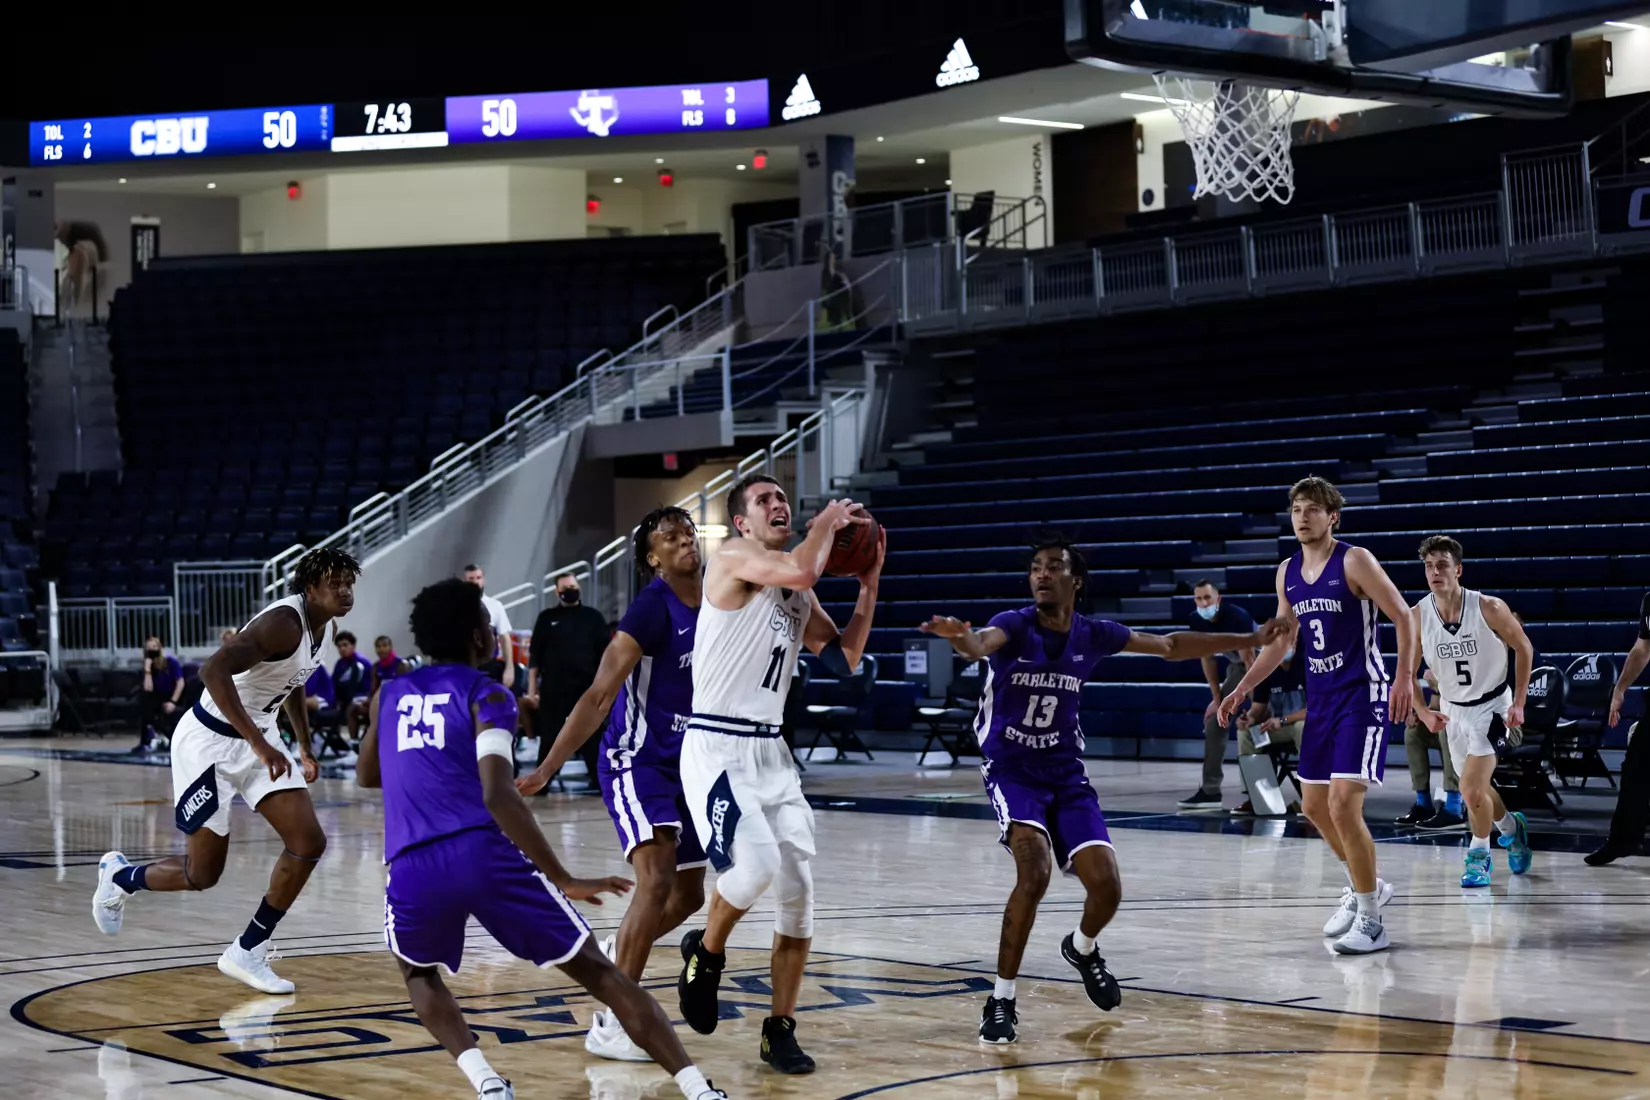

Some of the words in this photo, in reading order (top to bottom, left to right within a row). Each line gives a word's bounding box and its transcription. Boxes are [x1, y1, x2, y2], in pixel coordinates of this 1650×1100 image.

[725, 86, 736, 104] 3
[43, 124, 65, 141] TOL
[83, 121, 92, 139] 2
[262, 110, 297, 149] 50
[364, 102, 412, 134] 7:43
[481, 98, 517, 137] 50
[682, 109, 704, 126] FLS
[130, 115, 210, 157] CBU
[43, 144, 63, 160] FLS
[83, 142, 92, 159] 6
[1309, 618, 1326, 651] 3
[1307, 651, 1344, 674] STATE
[1436, 639, 1478, 660] CBU
[761, 644, 788, 693] 11
[1455, 660, 1473, 687] 5
[1572, 672, 1601, 681] adidas
[1011, 671, 1082, 694] TARLETON
[396, 692, 452, 752] 25
[1022, 694, 1059, 729] 13
[1005, 725, 1060, 749] STATE
[181, 784, 213, 822] LANCERS
